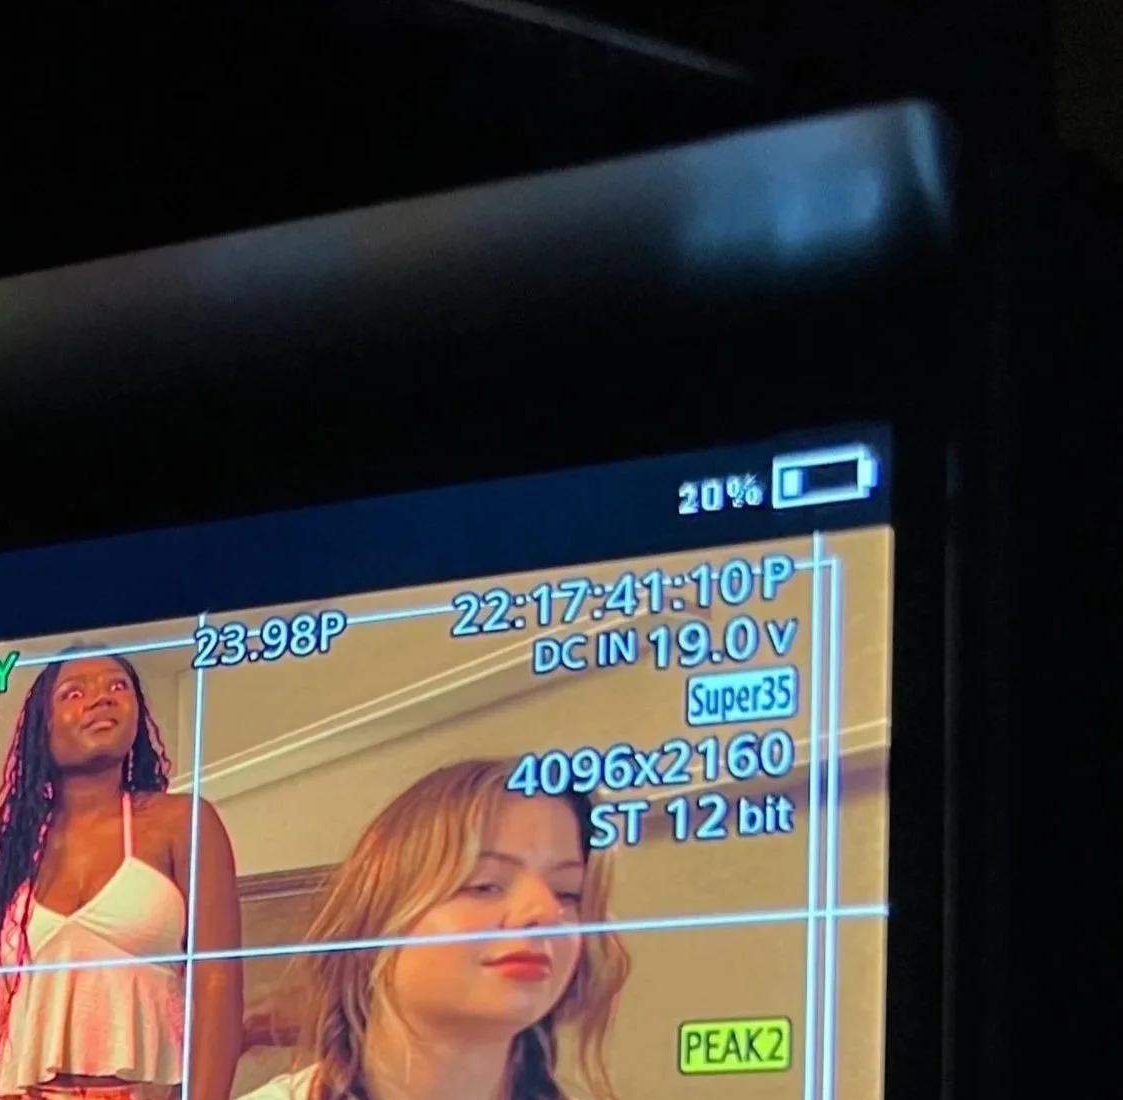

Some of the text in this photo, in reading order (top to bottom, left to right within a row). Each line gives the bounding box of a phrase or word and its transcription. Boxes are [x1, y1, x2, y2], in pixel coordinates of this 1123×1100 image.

[678, 473, 764, 515] 20%
[450, 558, 754, 637] 22:17:41:10
[191, 610, 347, 669] 23.98P
[532, 637, 588, 673] DC
[597, 629, 636, 667] IN
[647, 615, 759, 669] 19.0
[689, 674, 792, 721] Super35
[507, 731, 795, 797] 4096x2160
[588, 792, 795, 849] ST 12 bit
[684, 1026, 786, 1065] PEAK2
